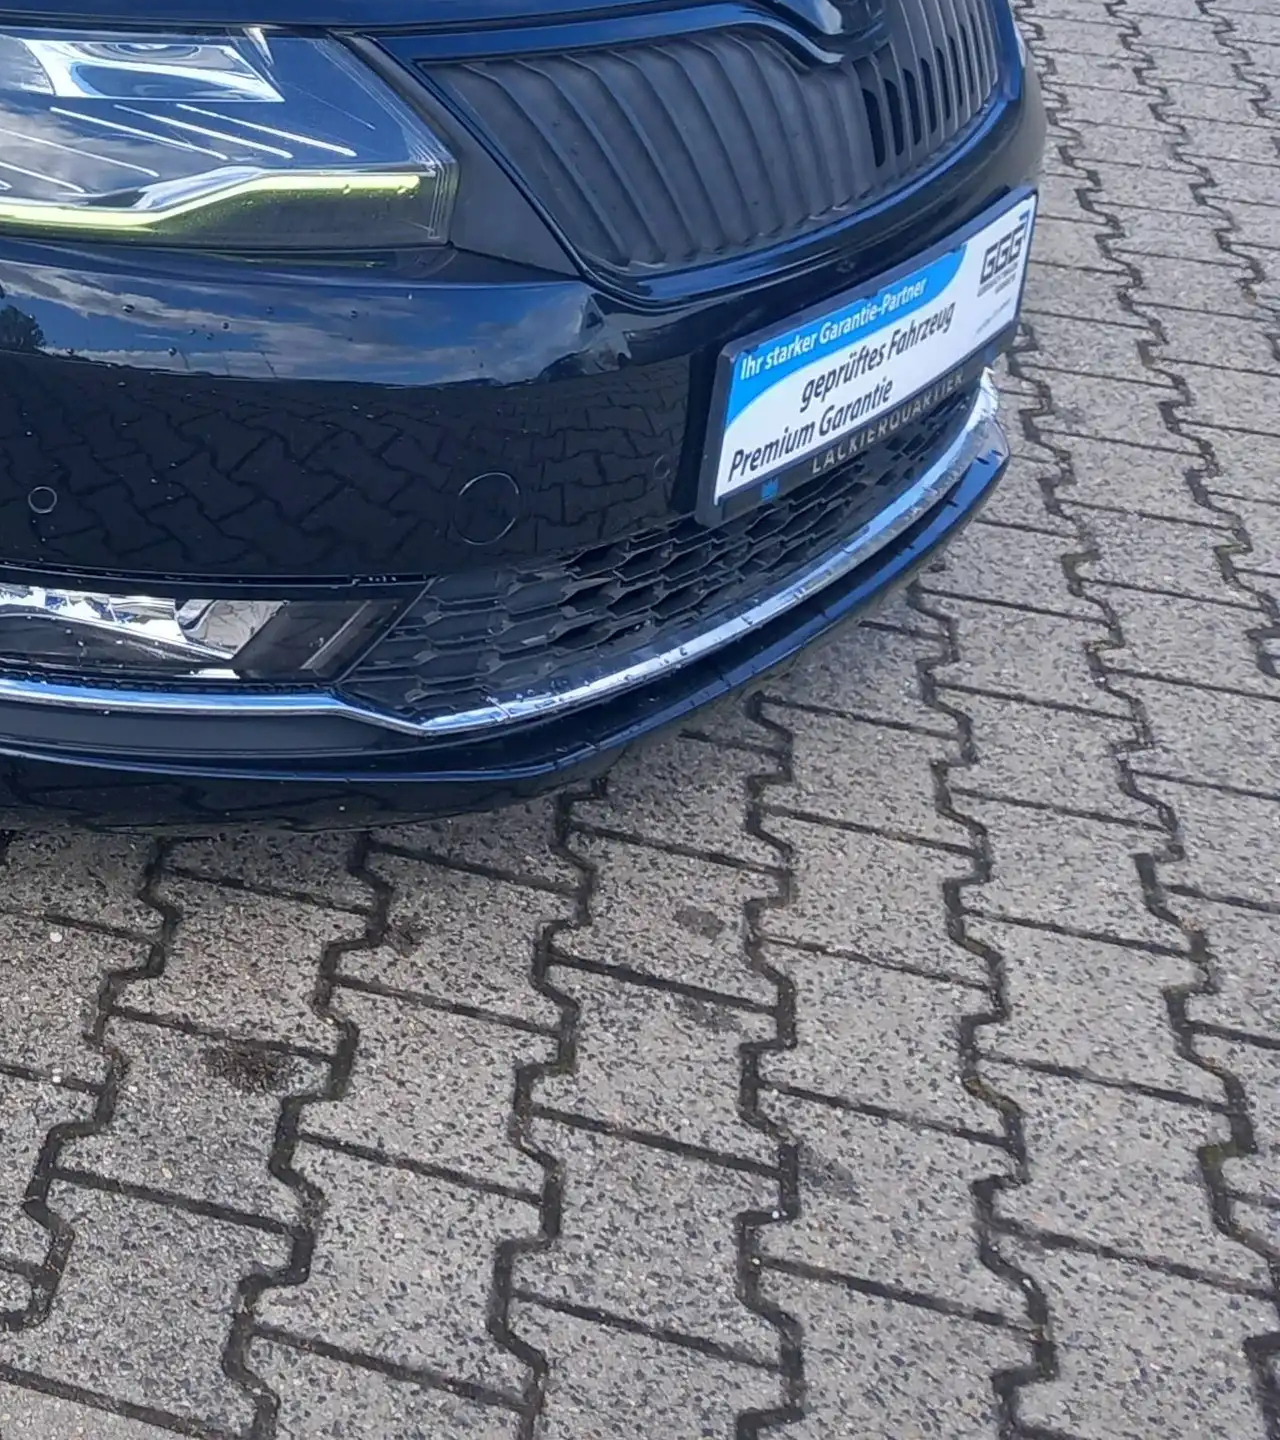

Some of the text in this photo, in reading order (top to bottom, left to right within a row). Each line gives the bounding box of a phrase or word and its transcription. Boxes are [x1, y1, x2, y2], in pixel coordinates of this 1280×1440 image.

[740, 353, 767, 381] Ihr
[765, 331, 818, 371] starker
[819, 277, 928, 345] Garantie-Partner
[800, 342, 887, 414] geprüftes
[887, 302, 957, 360] Fahrzeug
[727, 376, 894, 483] Premium Garantie
